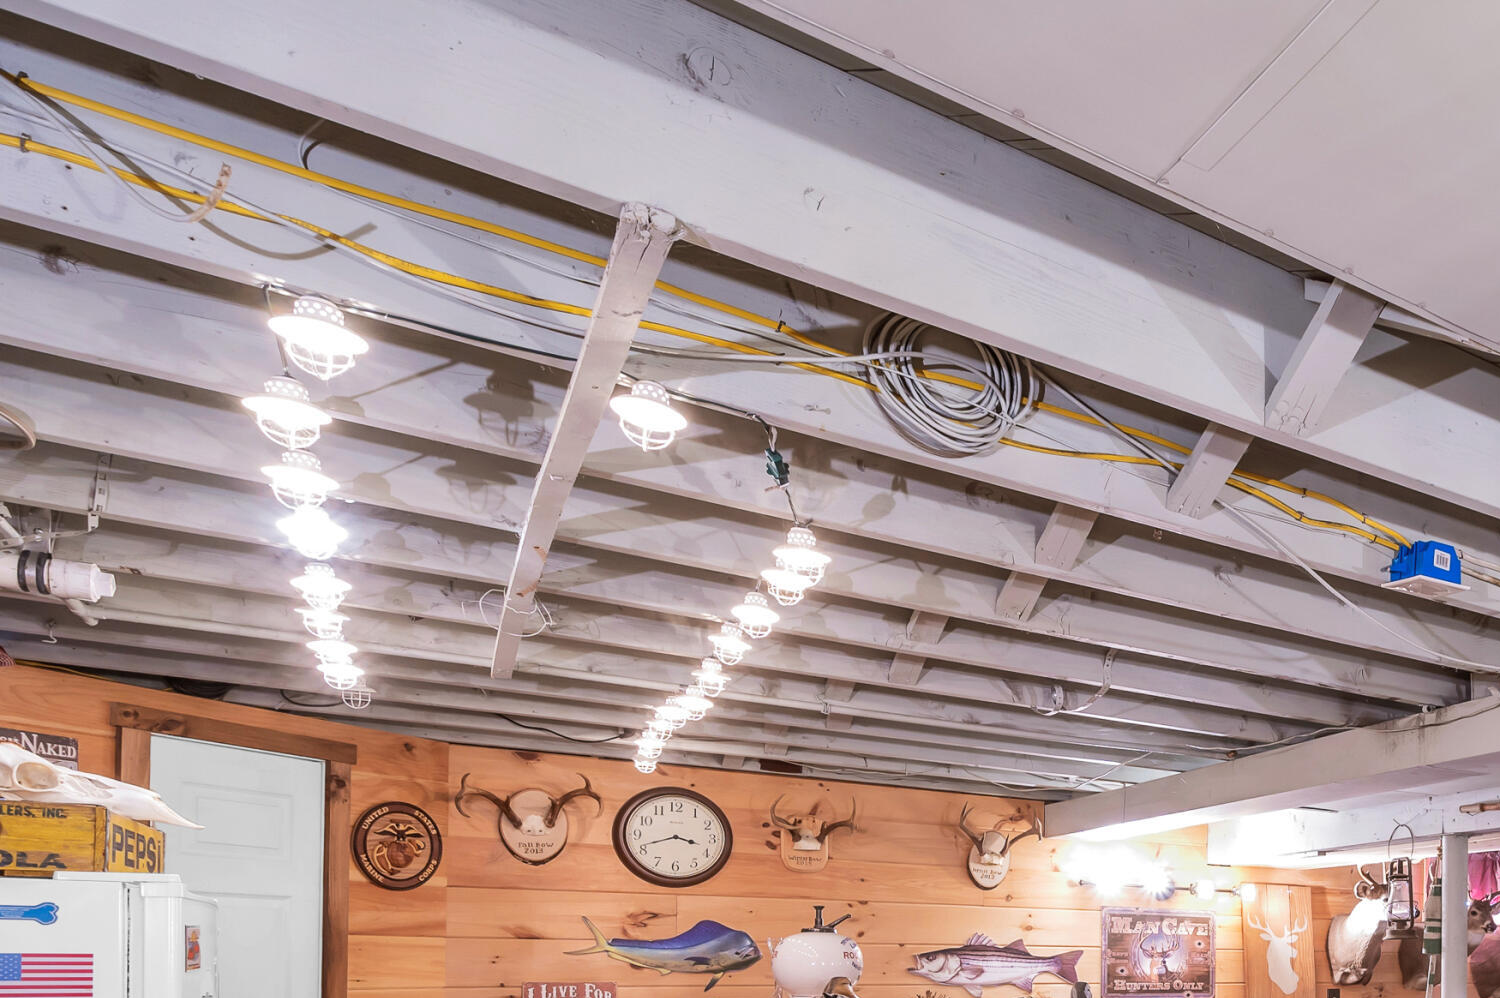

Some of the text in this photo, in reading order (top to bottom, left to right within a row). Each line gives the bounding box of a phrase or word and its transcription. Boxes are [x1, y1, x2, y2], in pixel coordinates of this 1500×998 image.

[20, 732, 77, 759] NAKED
[654, 805, 664, 815] 11
[670, 802, 683, 812] 12
[693, 808, 697, 818] 1
[362, 806, 437, 835] UNITED STATES
[640, 816, 653, 826] 10
[704, 820, 711, 830] 2
[633, 829, 642, 840] 9
[709, 834, 716, 844] 3
[112, 823, 161, 874] PEPSI
[640, 845, 648, 855] 8
[703, 848, 710, 858] 4
[654, 857, 661, 867] 7
[671, 861, 680, 872] 6
[690, 858, 698, 868] 5
[360, 854, 437, 882] MARINE CORPS
[1110, 917, 1208, 936] MAN CAVE
[1114, 979, 1204, 991] HUNTERS ONLY
